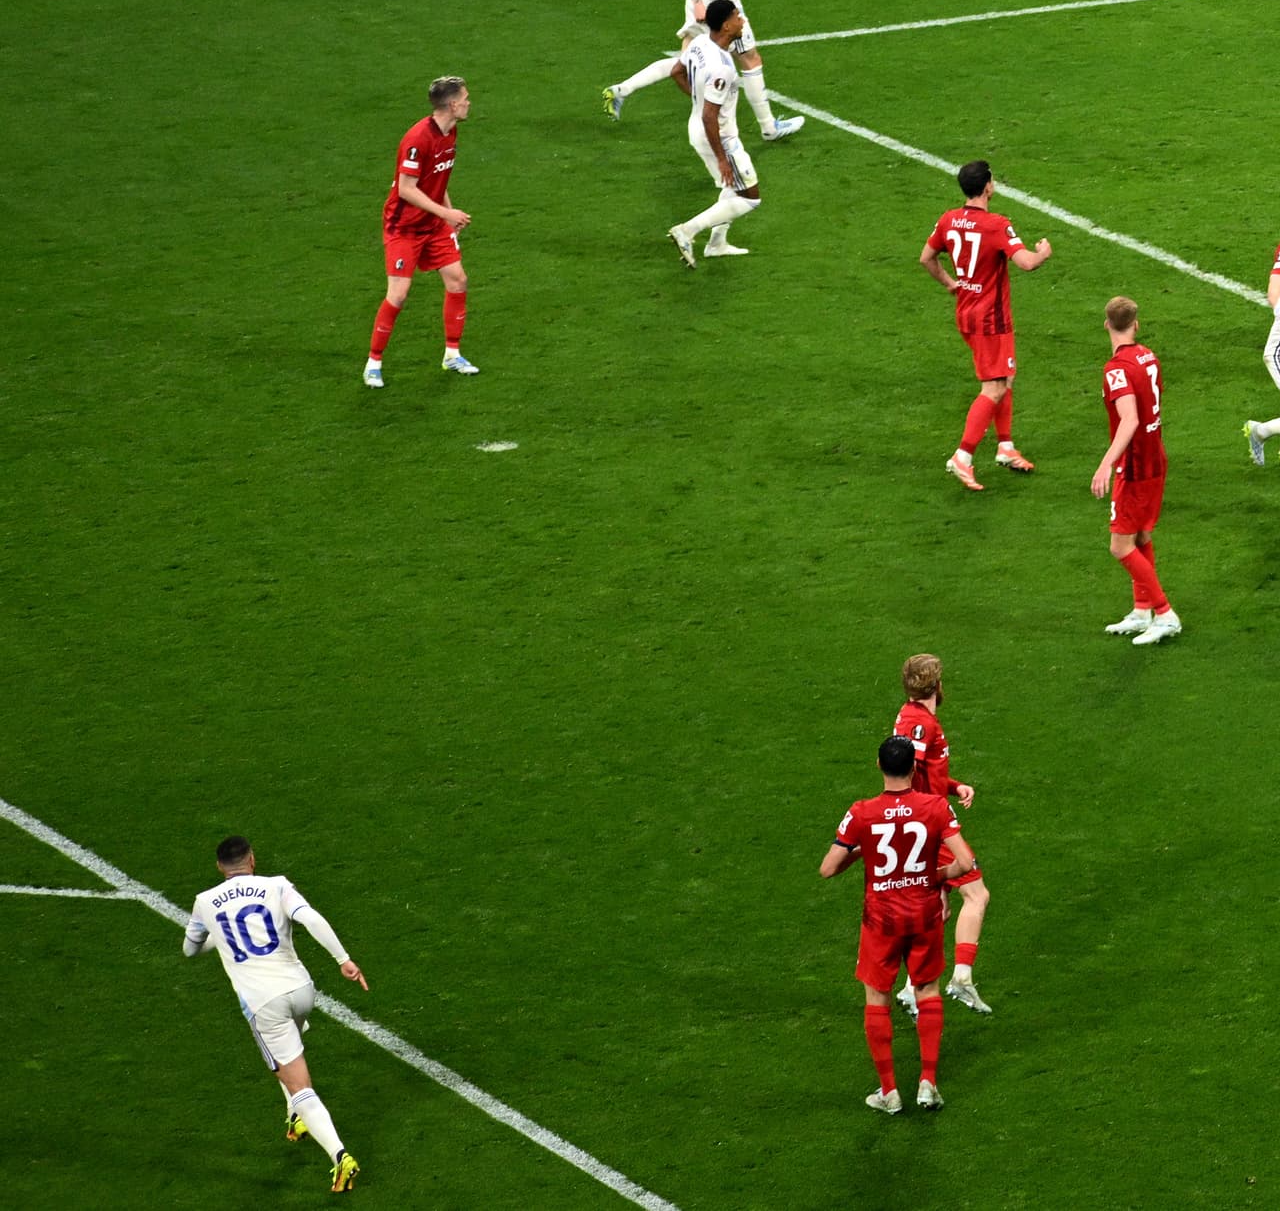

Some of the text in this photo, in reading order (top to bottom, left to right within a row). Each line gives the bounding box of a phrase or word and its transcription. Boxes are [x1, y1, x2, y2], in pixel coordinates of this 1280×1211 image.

[951, 217, 976, 229] höfler
[946, 230, 982, 278] 27
[1146, 364, 1160, 415] 3
[884, 805, 912, 819] grifo
[871, 821, 928, 877] 32
[212, 886, 267, 908] BUENDIA
[873, 875, 929, 892] scfreiburg
[215, 903, 280, 963] 10
